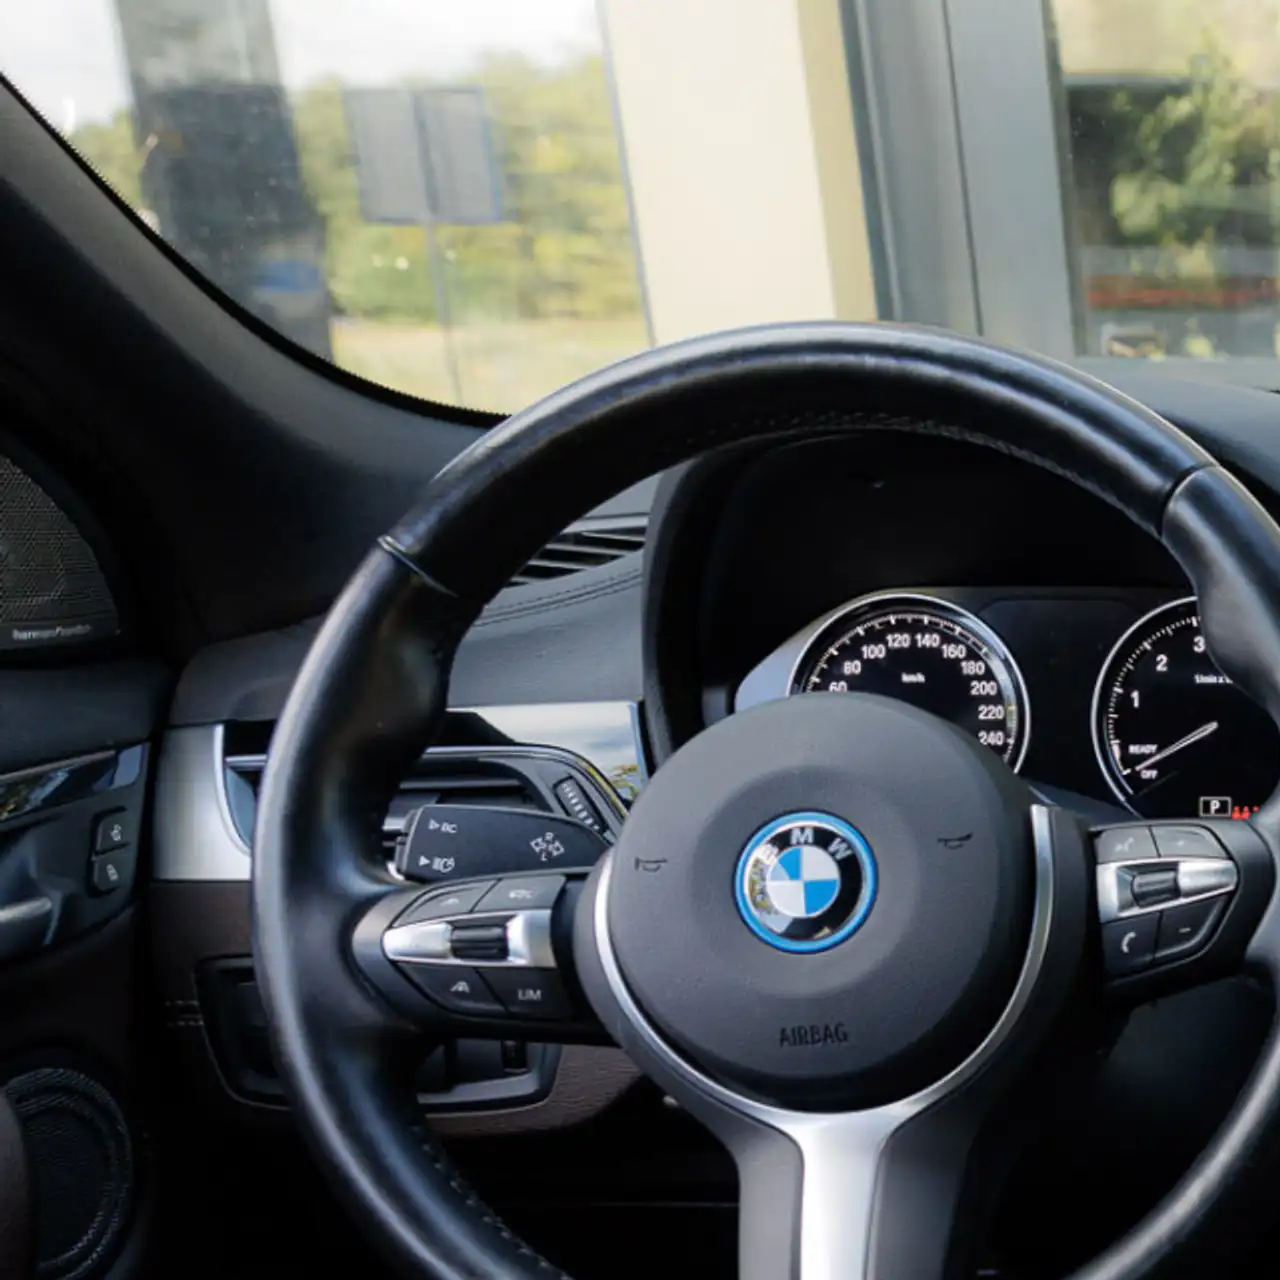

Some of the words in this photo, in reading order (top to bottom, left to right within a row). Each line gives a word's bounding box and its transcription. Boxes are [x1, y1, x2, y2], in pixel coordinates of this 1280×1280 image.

[886, 634, 910, 648] 120
[915, 634, 940, 648] 140
[1193, 636, 1205, 652] 3
[861, 644, 886, 659] 100
[941, 644, 966, 658] 160
[843, 660, 861, 674] 80
[961, 661, 985, 675] 180
[1156, 654, 1167, 672] 2
[902, 672, 925, 683] km/h
[971, 682, 997, 695] 200
[1130, 690, 1139, 708] 1
[978, 706, 1004, 720] 220
[978, 731, 1003, 746] 240
[1140, 770, 1158, 779] OFF
[1210, 800, 1220, 814] P
[762, 827, 855, 864] BMW
[518, 989, 541, 1001] LIM
[780, 1022, 848, 1048] AIRBAG
